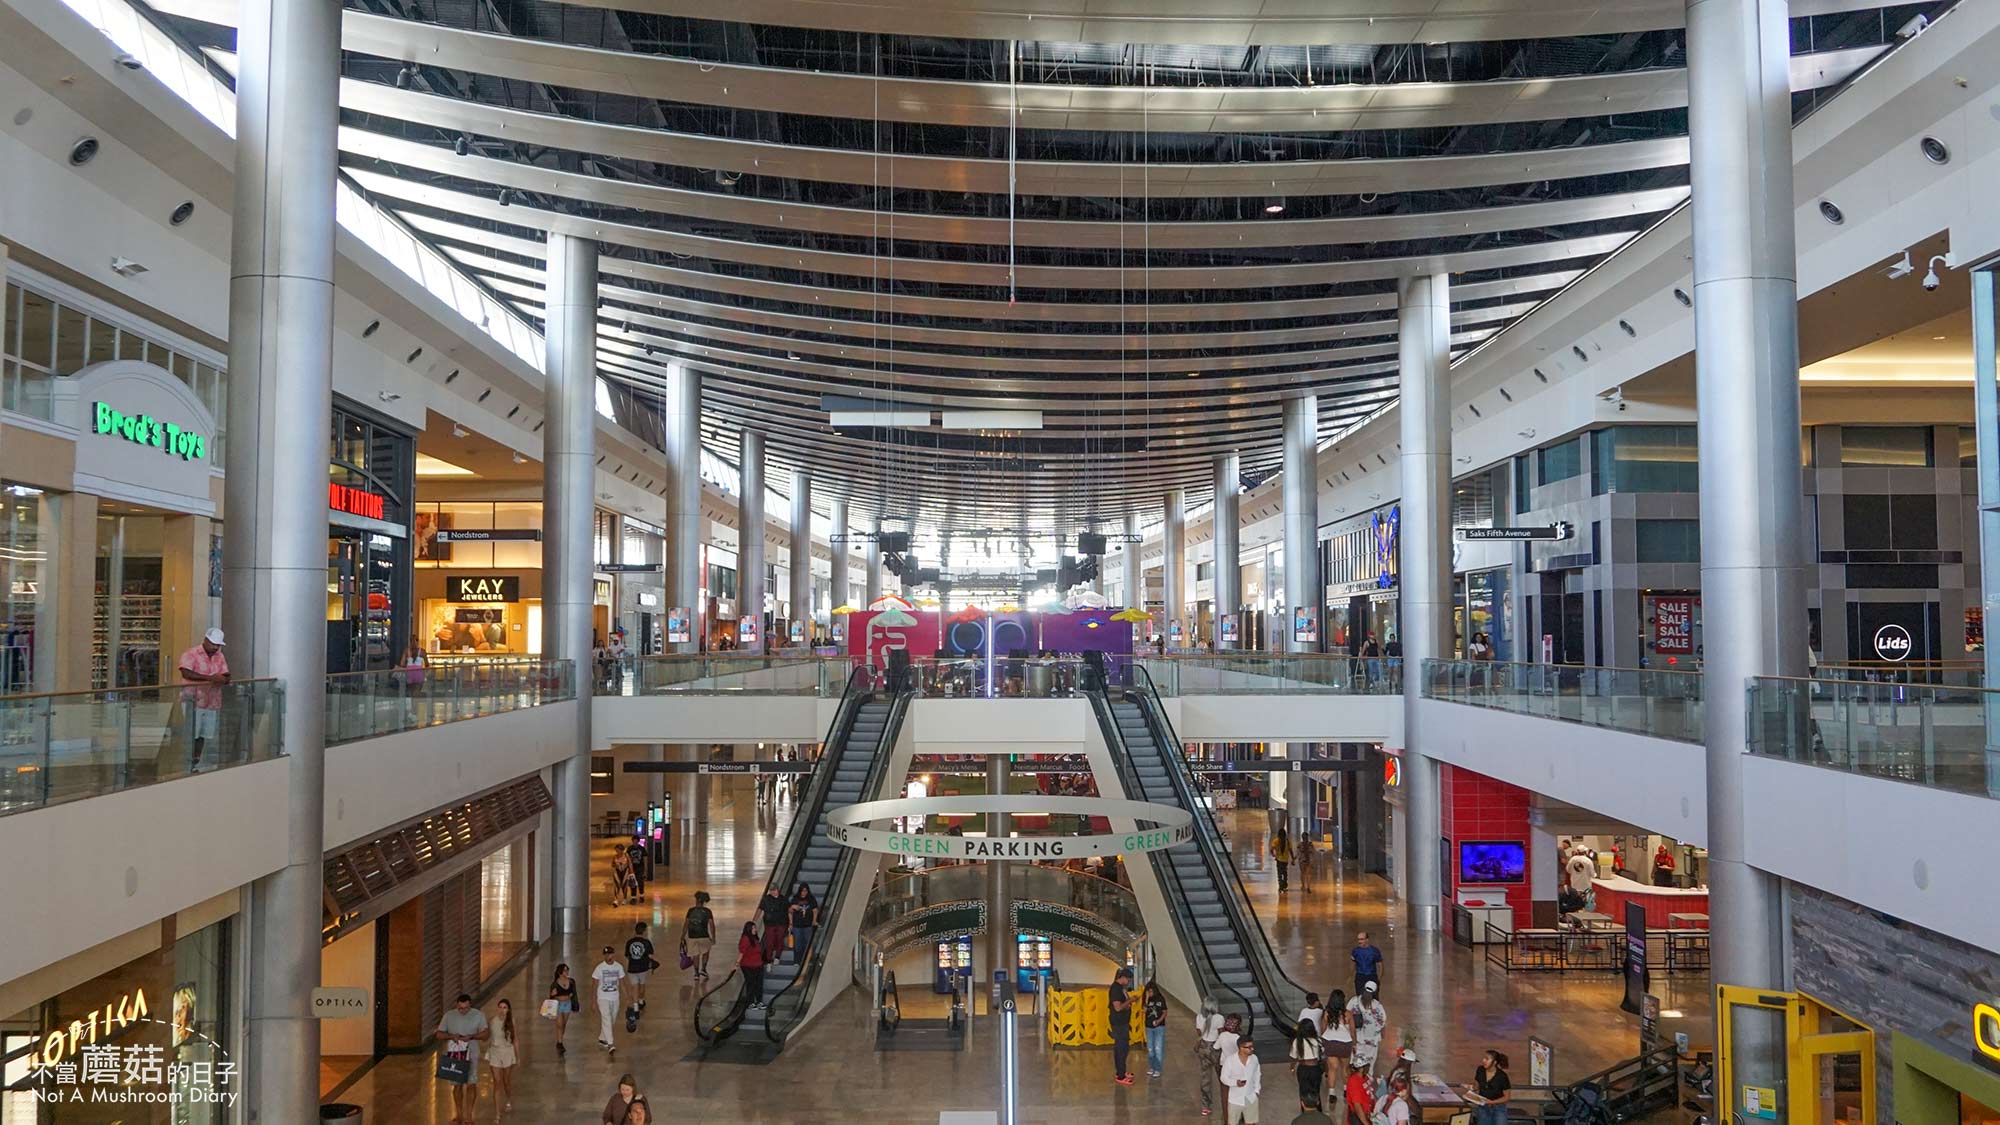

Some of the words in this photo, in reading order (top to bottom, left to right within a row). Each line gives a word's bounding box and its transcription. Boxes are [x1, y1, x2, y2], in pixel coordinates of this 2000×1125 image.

[92, 400, 161, 447] Brad's
[163, 422, 205, 460] Toys
[329, 482, 347, 512] OLT
[349, 487, 385, 520] TATTOOS
[451, 531, 489, 539] Nordstrom
[1486, 529, 1503, 537] Fifth
[461, 579, 504, 594] KAY
[461, 593, 504, 601] JEWELERS
[1659, 603, 1688, 613] SALE
[1660, 638, 1689, 648] SALE
[1878, 636, 1908, 650] Lids
[709, 763, 745, 771] Nordstrom
[888, 836, 949, 854] GREEN
[965, 841, 1063, 856] PARKING
[1124, 832, 1170, 851] GREEN
[916, 922, 927, 934] LOT
[1069, 923, 1089, 938] GREEN
[315, 998, 363, 1007] OPTICA
[44, 988, 148, 1068] OPTICA
